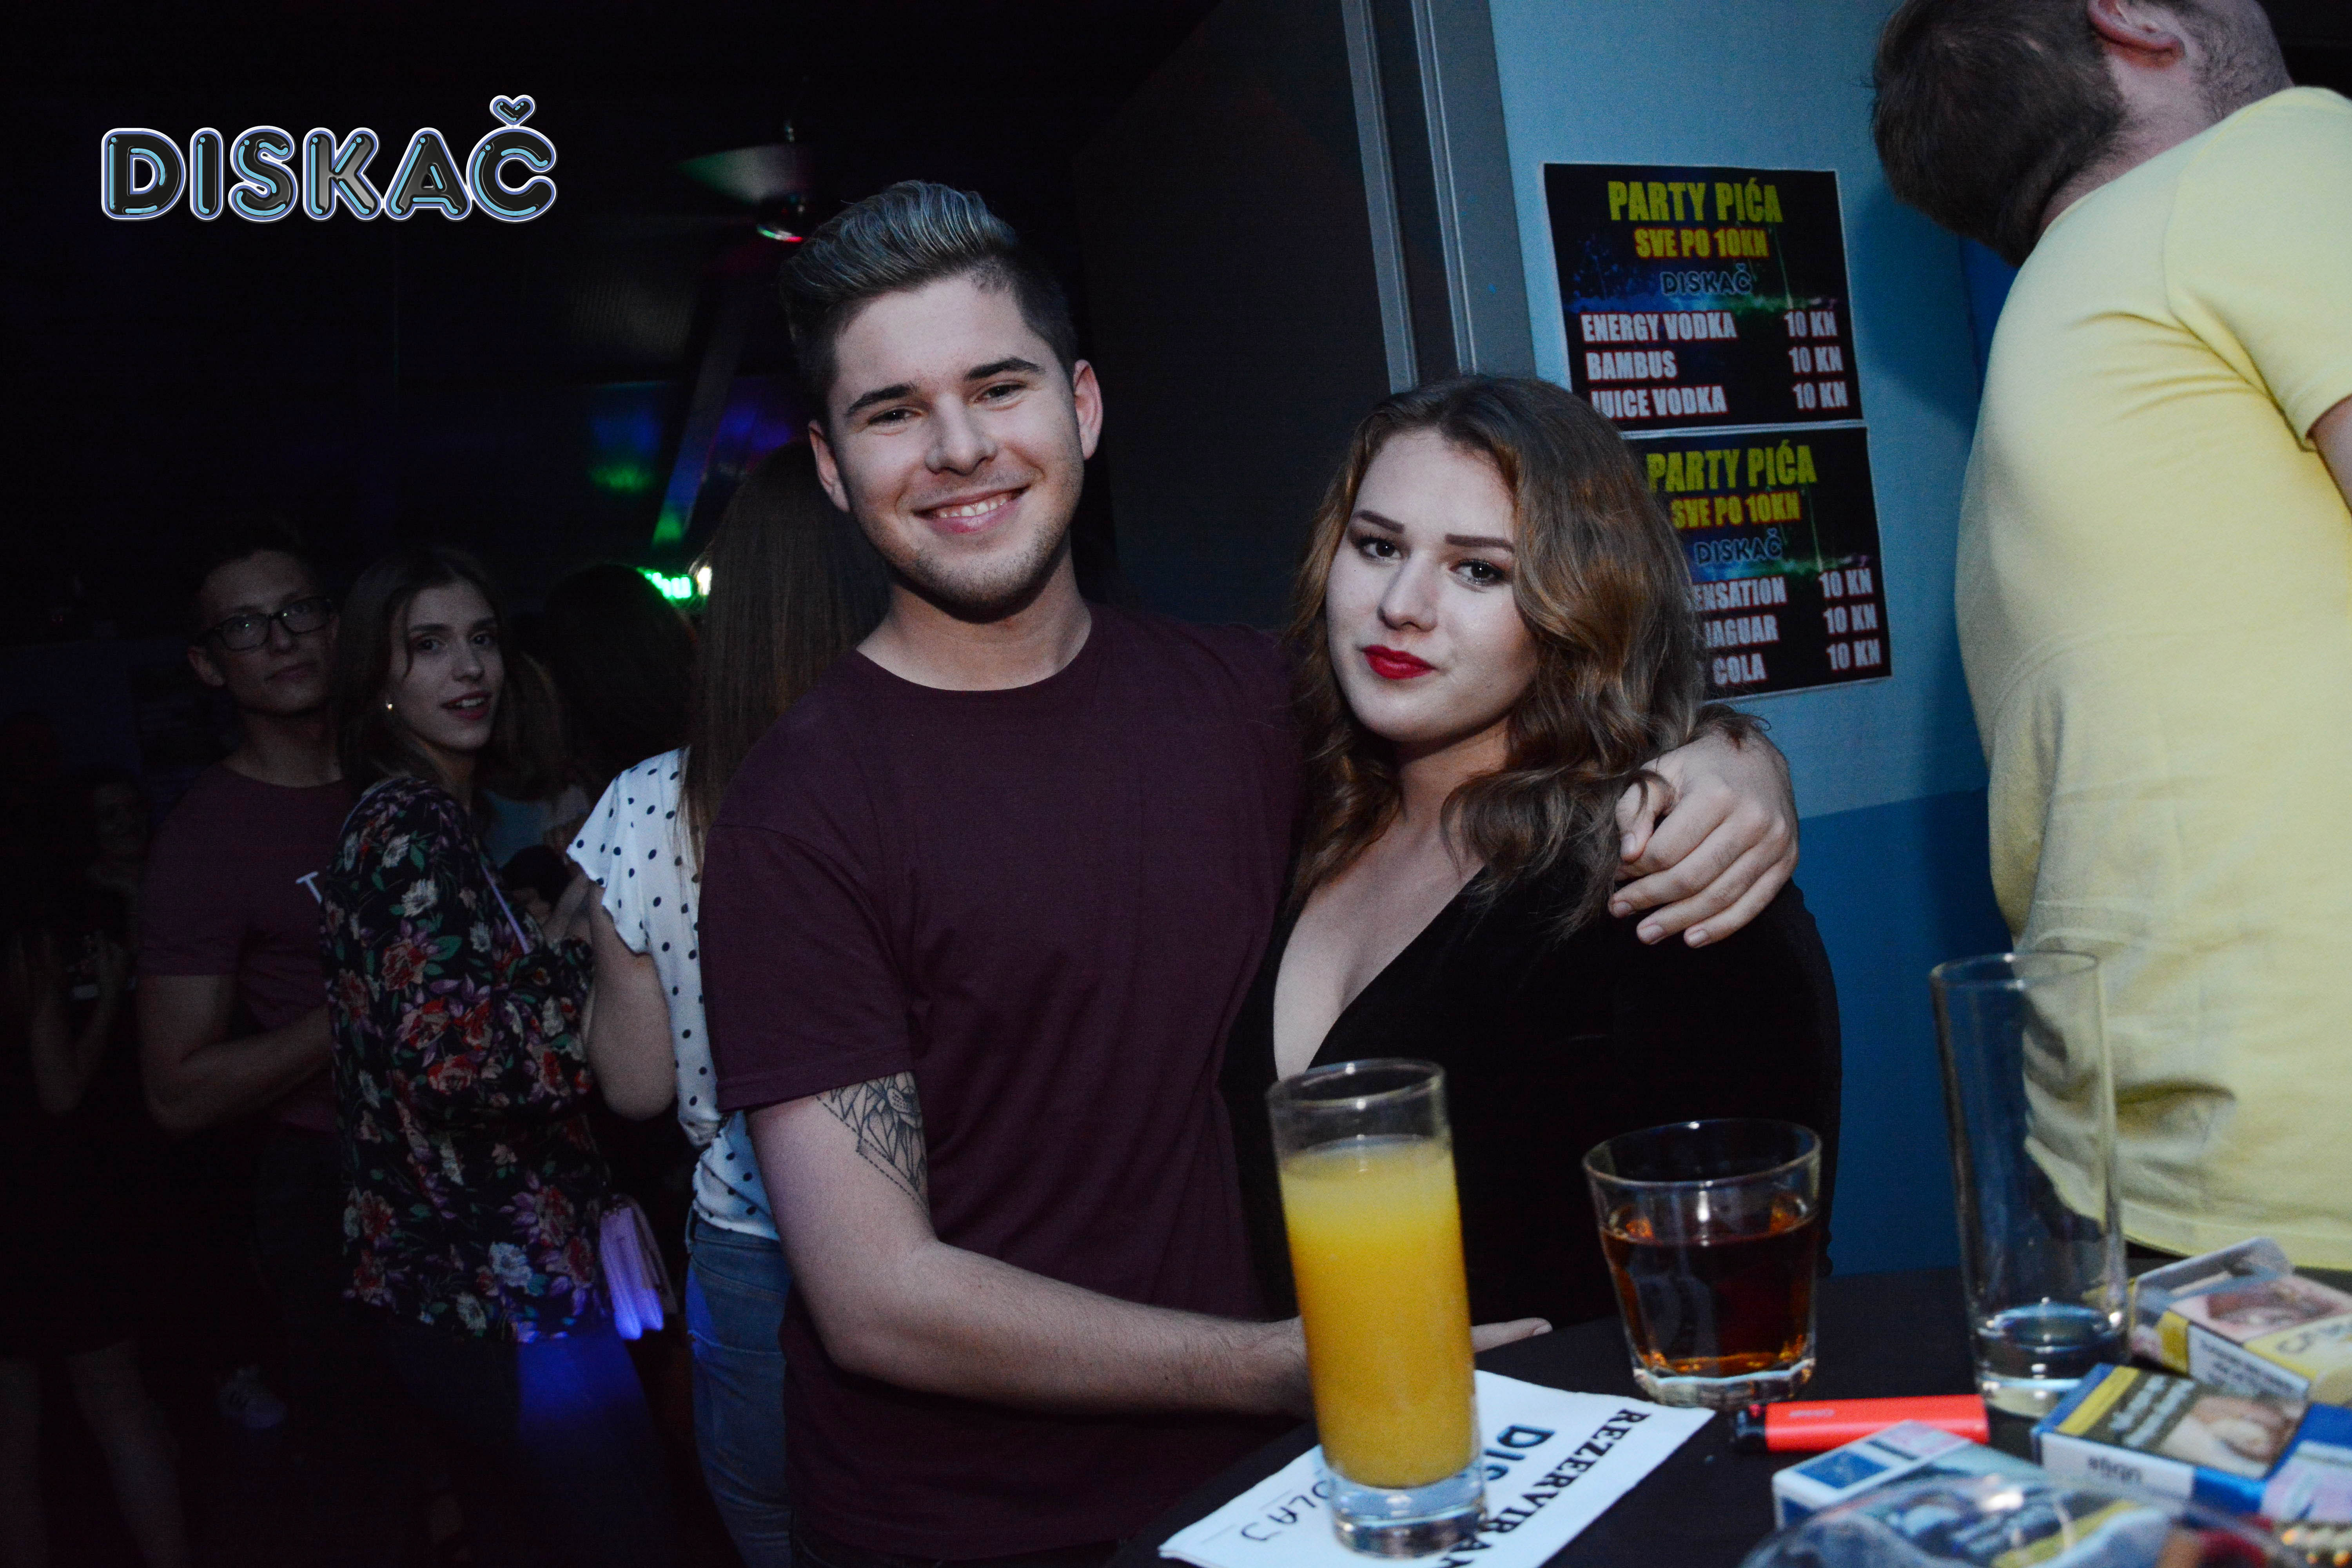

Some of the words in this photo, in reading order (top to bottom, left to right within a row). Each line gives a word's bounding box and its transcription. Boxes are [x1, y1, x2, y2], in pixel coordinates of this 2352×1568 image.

[1608, 181, 1706, 221] PARTY
[1714, 177, 1784, 223] PIĆA
[1634, 227, 1678, 258] SVE
[1680, 228, 1711, 258] PO
[1713, 227, 1769, 258] 10KN
[1659, 263, 1753, 295] DISKAČ
[1581, 313, 1659, 342] ENERGY
[1662, 312, 1737, 340] VODKA
[1784, 310, 1807, 337] 10
[1809, 311, 1838, 337] KN
[1586, 350, 1678, 380] BAMBUS
[1788, 346, 1812, 373] 10
[1814, 346, 1844, 372] KN
[1652, 385, 1727, 416] VODKA
[1793, 382, 1816, 409] 10
[1818, 381, 1849, 408] KN
[1646, 448, 1740, 494] PARTY
[1747, 439, 1817, 486] PIĆA
[1670, 497, 1712, 530] SVE
[1713, 495, 1743, 526] PO
[1745, 491, 1801, 523] 10KN
[1693, 527, 1783, 565] DISKAČ
[1686, 575, 1788, 612] ENSATION
[1818, 571, 1843, 598] 10
[1845, 568, 1873, 596] KN
[1823, 606, 1847, 634] 10
[1850, 603, 1877, 632] KN
[1712, 653, 1767, 685] COLA
[1826, 642, 1851, 670] 10
[1853, 638, 1881, 667] KN
